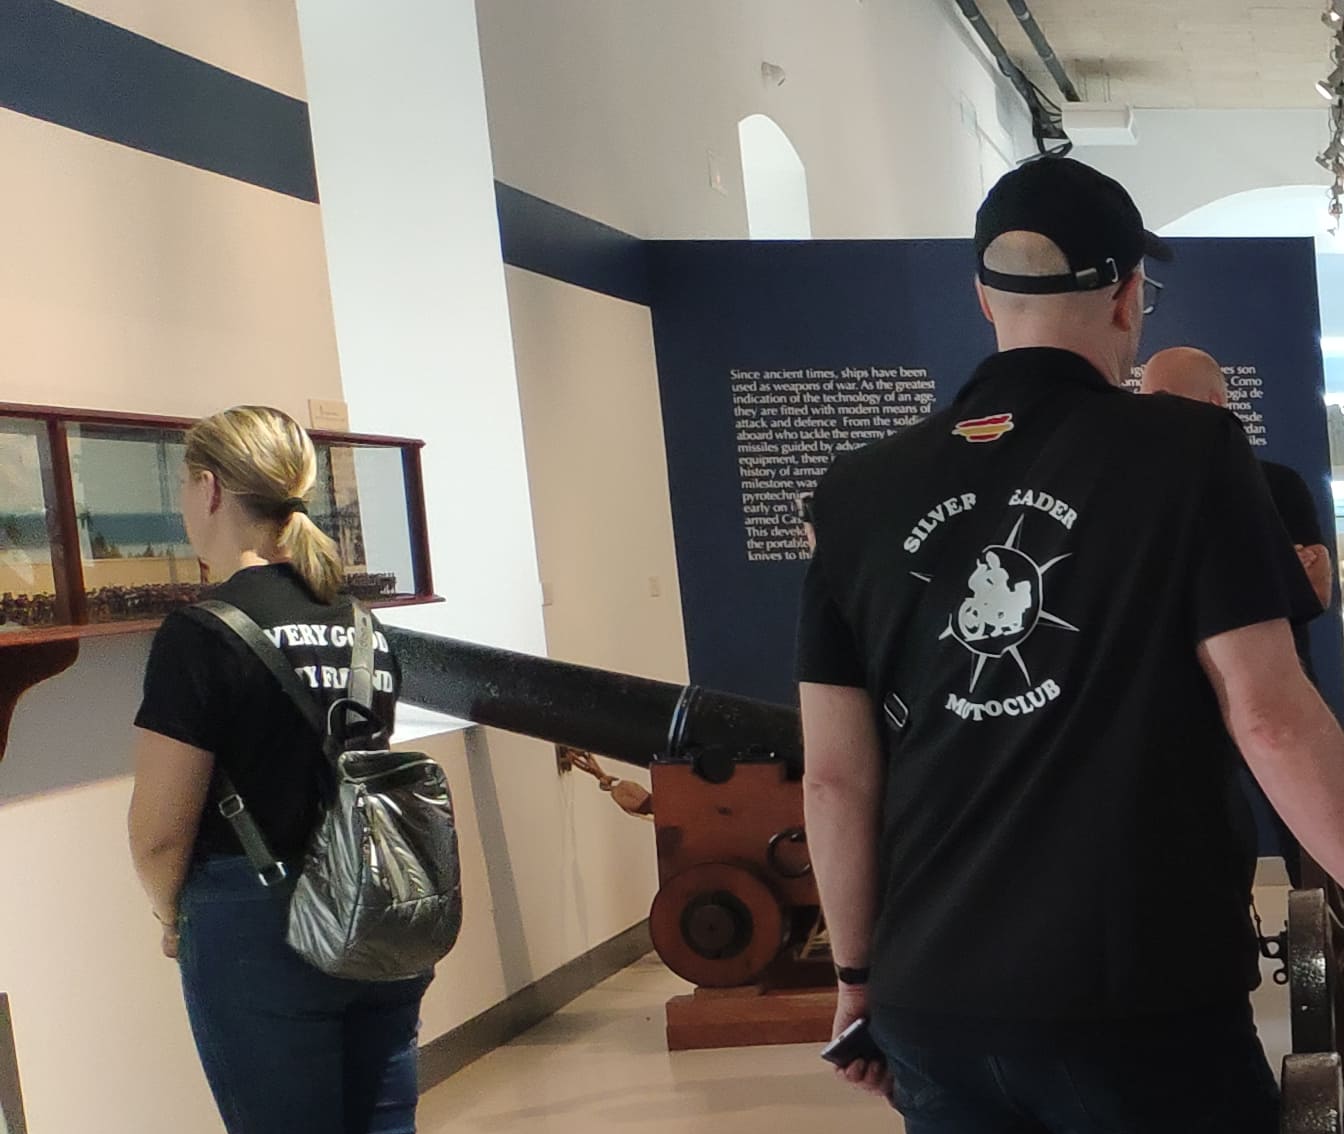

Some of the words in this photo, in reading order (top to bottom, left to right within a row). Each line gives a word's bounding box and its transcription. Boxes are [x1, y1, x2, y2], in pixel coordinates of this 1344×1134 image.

[730, 369, 760, 380] Since
[763, 368, 803, 380] ancient
[841, 367, 870, 381] ships
[871, 366, 897, 378] have
[900, 366, 927, 378] been
[1236, 366, 1256, 375] son
[732, 381, 757, 392] used
[759, 382, 771, 391] as
[773, 382, 821, 394] weapons
[823, 380, 835, 391] of
[860, 379, 875, 390] As
[876, 379, 893, 390] the
[895, 379, 936, 392] greatest
[1230, 376, 1263, 387] Como
[733, 392, 787, 404] indication
[789, 392, 801, 404] of
[802, 392, 820, 403] the
[823, 391, 881, 404] technology
[884, 390, 896, 402] of
[898, 392, 912, 402] an
[1249, 388, 1264, 399] de
[734, 405, 756, 418] they
[760, 406, 778, 416] are
[780, 404, 809, 416] fitted
[811, 403, 835, 415] with
[837, 403, 880, 415] modern
[882, 404, 917, 414] means
[920, 402, 932, 413] of
[735, 417, 768, 429] attack
[770, 416, 792, 428] and
[794, 416, 837, 428] defence
[843, 416, 871, 427] From
[873, 415, 891, 426] the
[736, 429, 773, 441] aboard
[775, 428, 798, 440] who
[800, 427, 831, 439] tackle
[832, 427, 849, 439] the
[850, 429, 885, 441] enemy
[737, 441, 779, 453] missiles
[781, 440, 818, 454] guided
[820, 439, 833, 453] by
[801, 452, 829, 464] there
[740, 466, 777, 479] history
[779, 465, 790, 476] of
[741, 478, 794, 489] milestone
[796, 479, 818, 488] was
[743, 502, 771, 514] early
[773, 503, 788, 512] on
[744, 514, 780, 526] armed
[746, 525, 769, 537] This
[747, 538, 764, 550] the
[766, 537, 809, 551] portable
[748, 550, 783, 561] knives
[785, 550, 796, 560] to
[263, 623, 329, 649] VERY
